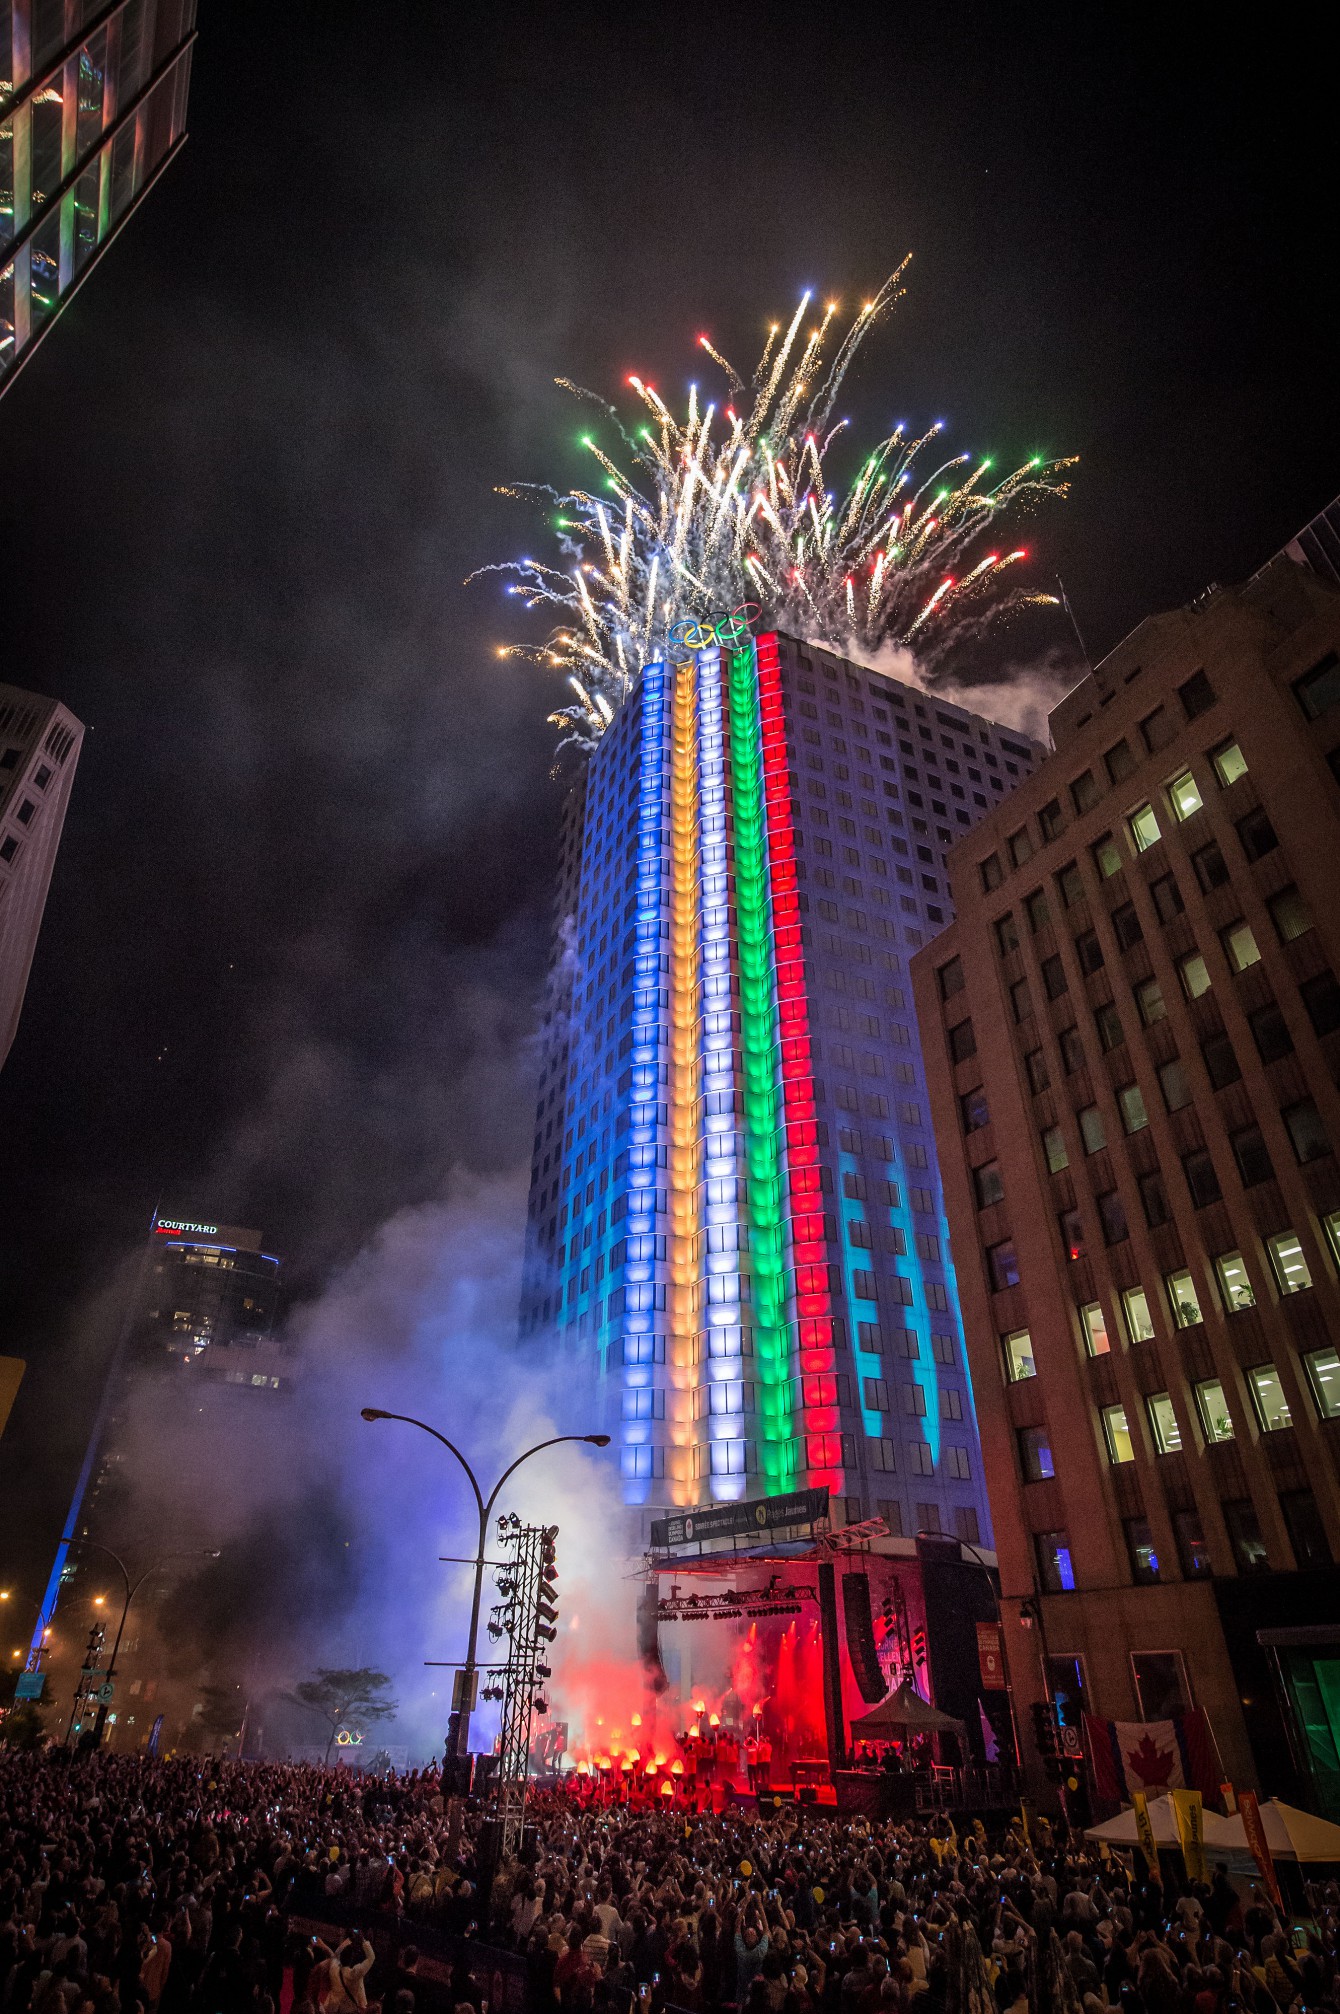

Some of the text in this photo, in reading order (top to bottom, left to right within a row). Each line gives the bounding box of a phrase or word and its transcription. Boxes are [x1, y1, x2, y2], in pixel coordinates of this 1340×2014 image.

[157, 1219, 217, 1234] COURTYARD
[785, 1505, 807, 1517] Jaunes
[1189, 1804, 1198, 1846] Jaunes
